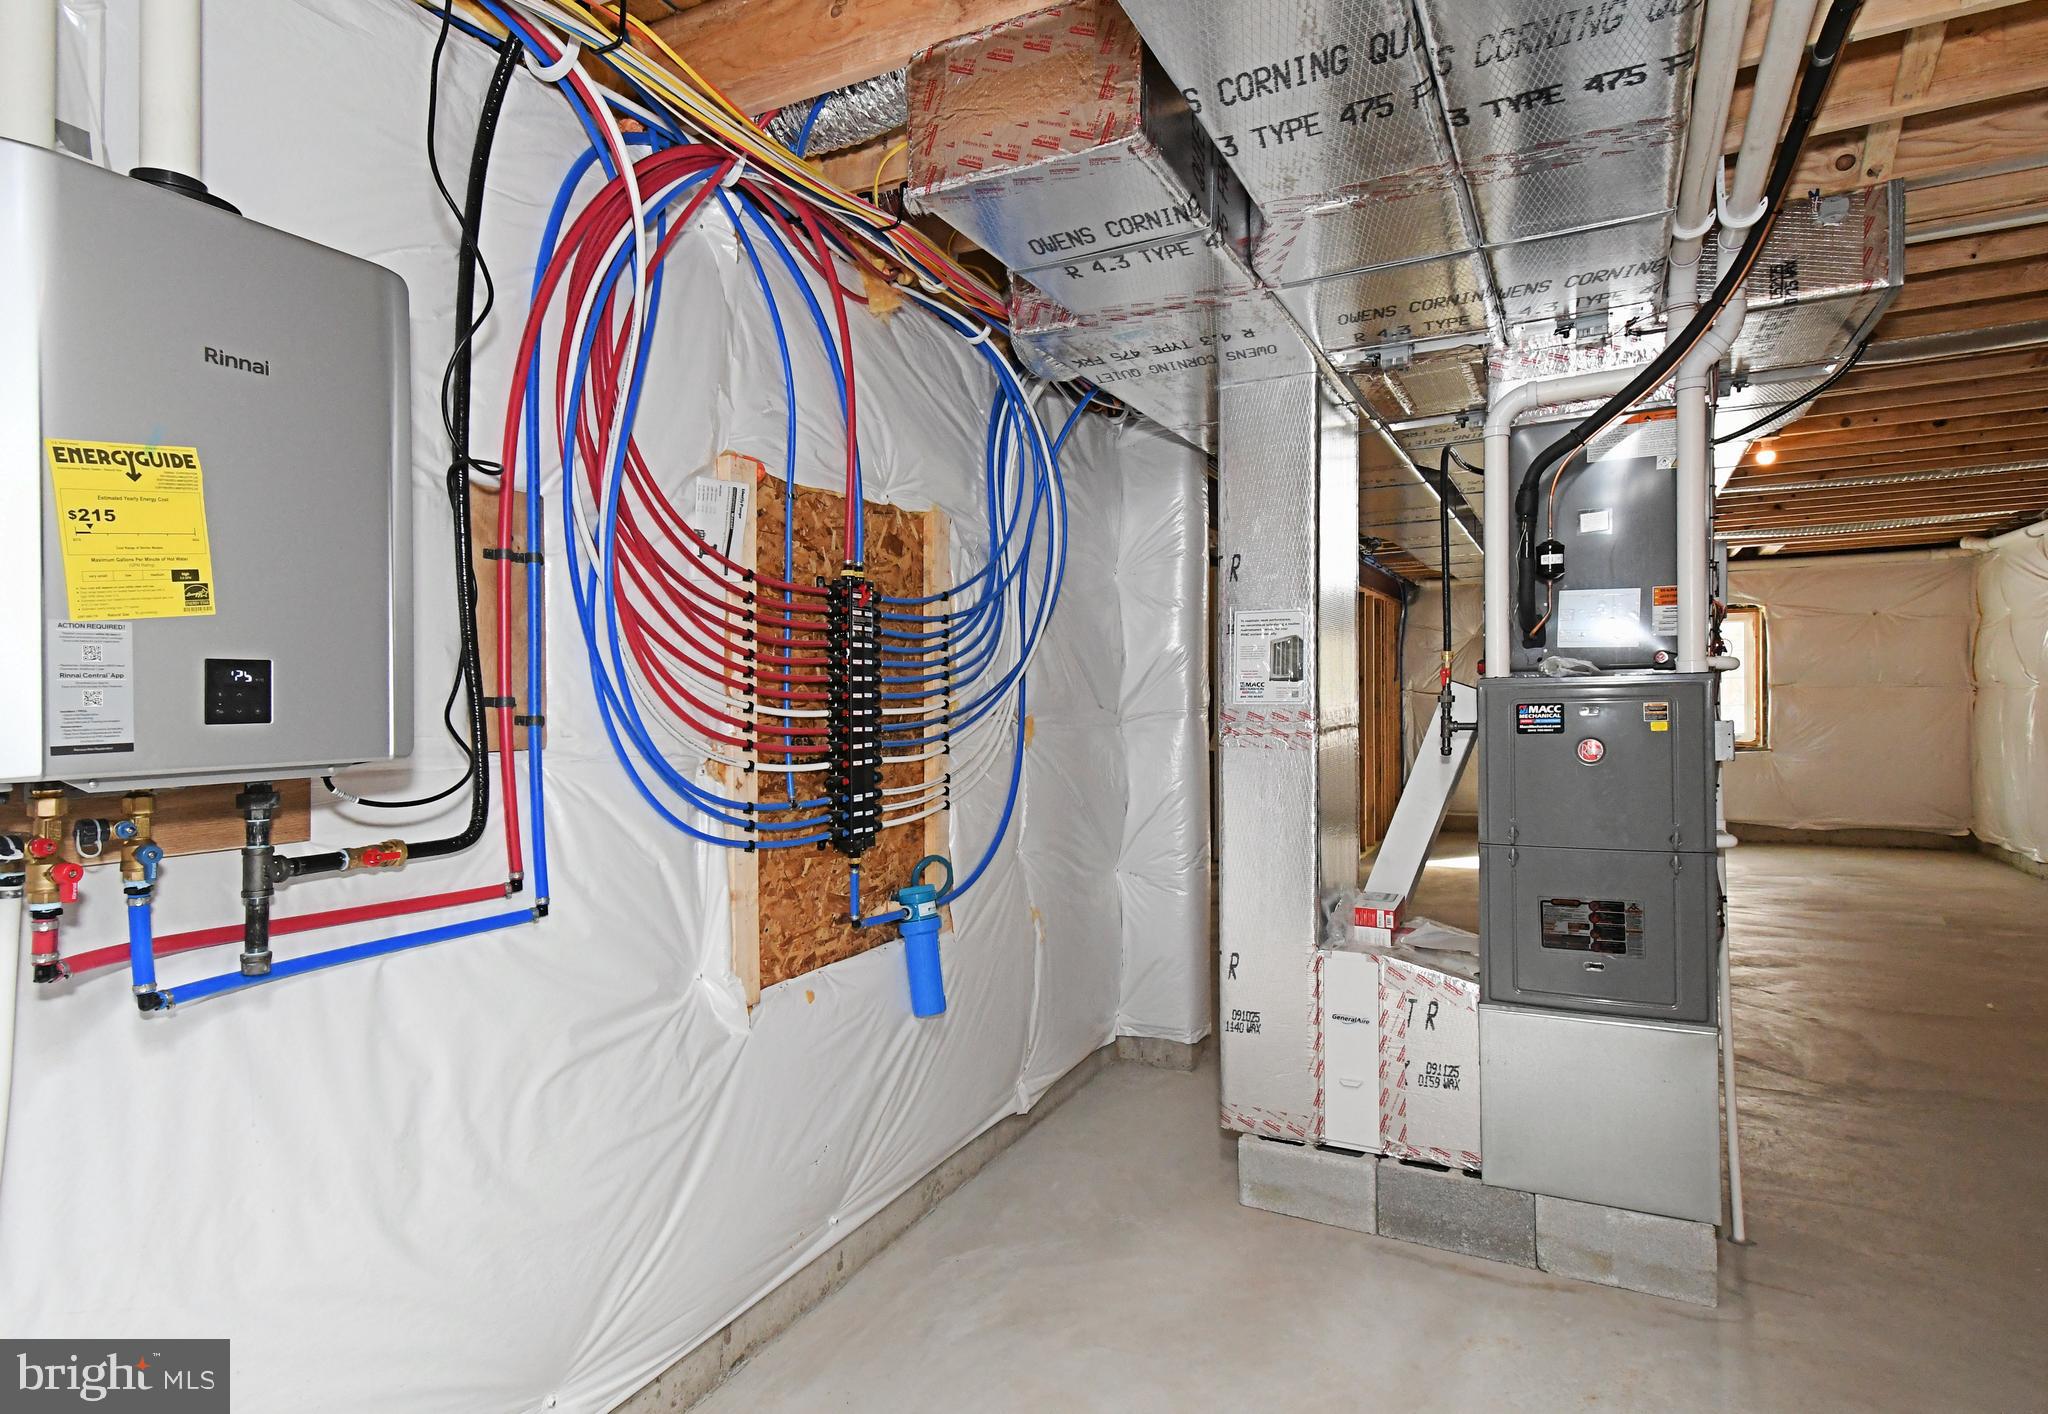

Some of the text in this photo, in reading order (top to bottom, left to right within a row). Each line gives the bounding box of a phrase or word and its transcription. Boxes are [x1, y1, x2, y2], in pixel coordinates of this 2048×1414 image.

[1217, 44, 1349, 106] CORNING
[1479, 84, 1566, 117] TYPE
[1583, 63, 1647, 92] 475
[1249, 112, 1323, 148] TYPE
[1340, 92, 1395, 125] 475
[1028, 227, 1096, 255] OWENS
[1105, 193, 1201, 238] CORNING
[1064, 266, 1084, 280] R
[1092, 255, 1131, 274] 4.3
[1138, 241, 1195, 264] TYPE
[1564, 256, 1668, 288] CORNING
[1575, 290, 1624, 308] TYPE
[1337, 305, 1397, 325] OWENS
[1241, 328, 1256, 338] R
[1353, 315, 1471, 343] R 4.3 TYPE
[1110, 349, 1141, 362] 475
[1148, 340, 1194, 355] TYPE
[1226, 344, 1278, 361] OWENS
[204, 346, 270, 376] Rinnai
[1071, 357, 1107, 369] FRK
[1149, 354, 1218, 374] CORNING
[53, 446, 197, 472] ENERGYGUIDE
[68, 508, 116, 522] $215
[1229, 554, 1241, 582] R
[1528, 705, 1562, 714] MACC
[1228, 952, 1240, 980] R
[1331, 1014, 1370, 1024] GeneralAire
[1425, 1001, 1439, 1031] R
